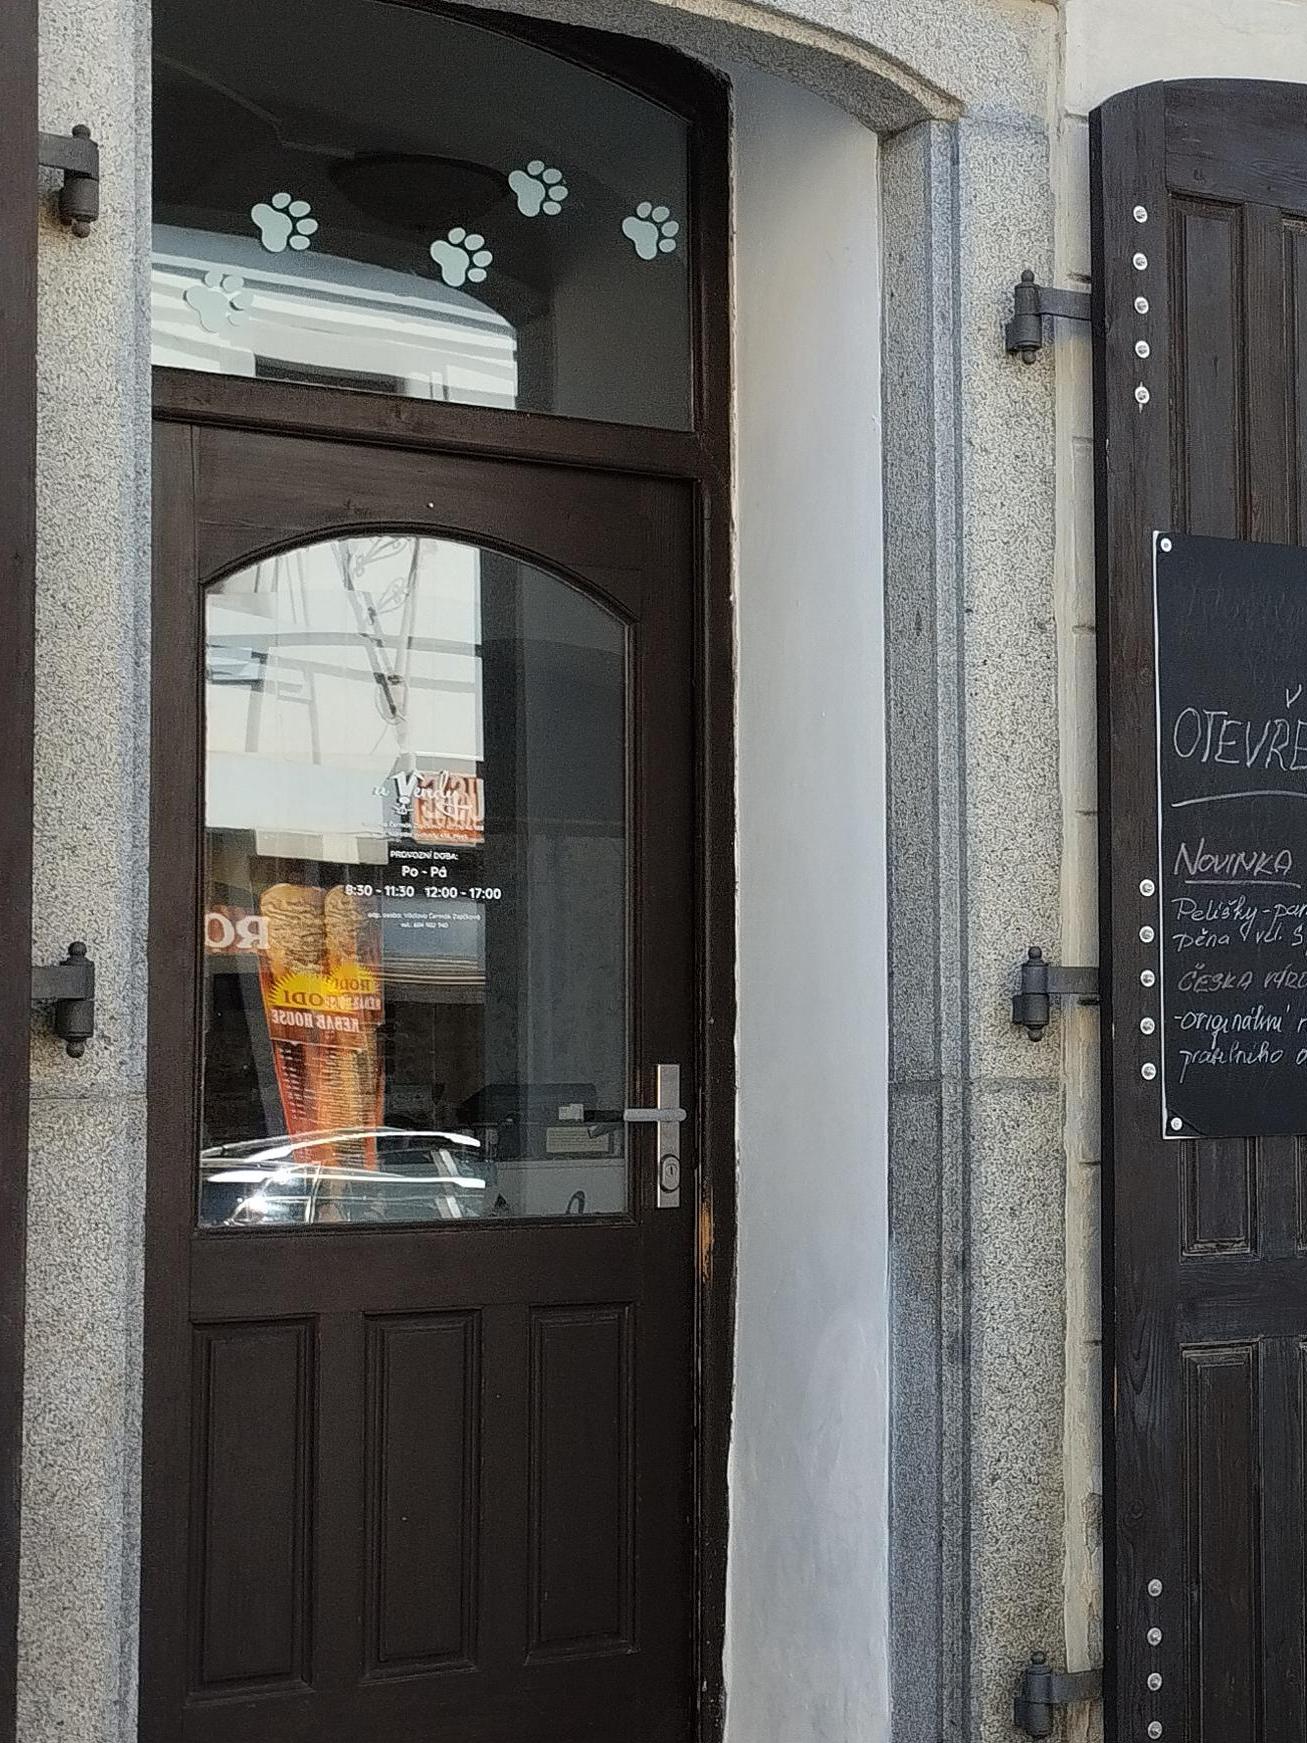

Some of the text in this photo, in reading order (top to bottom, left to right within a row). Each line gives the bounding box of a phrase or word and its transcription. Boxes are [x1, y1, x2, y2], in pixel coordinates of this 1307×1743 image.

[401, 865, 419, 878] Po
[430, 866, 448, 878] Pá
[345, 884, 373, 896] 8:30
[384, 885, 415, 898] 11:30
[424, 886, 458, 898] 12:00
[469, 888, 502, 900] 17:00
